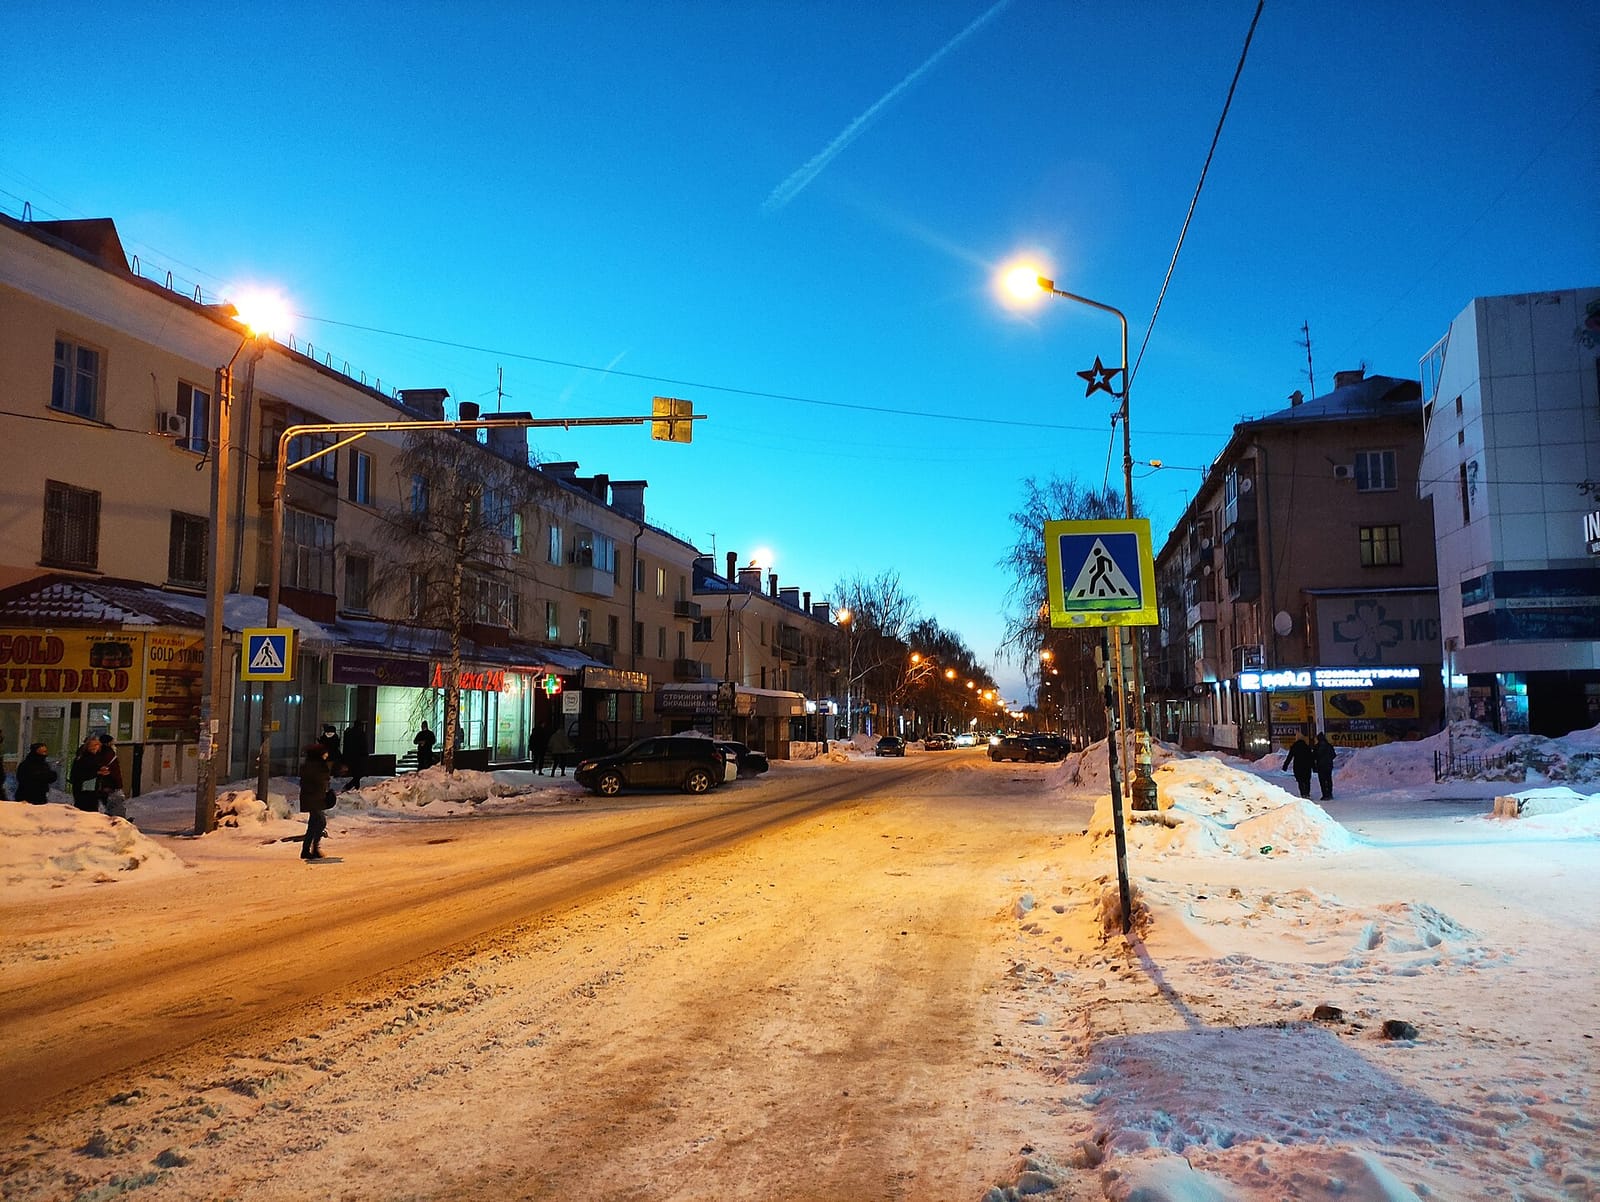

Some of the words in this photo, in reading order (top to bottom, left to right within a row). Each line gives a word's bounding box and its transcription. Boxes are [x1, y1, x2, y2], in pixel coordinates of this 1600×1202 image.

[1410, 618, 1440, 641] ИС
[0, 635, 64, 664] GOLD
[151, 646, 173, 662] GOLD
[177, 648, 204, 664] STAND
[1332, 733, 1378, 741] ФЛЕШКИ
